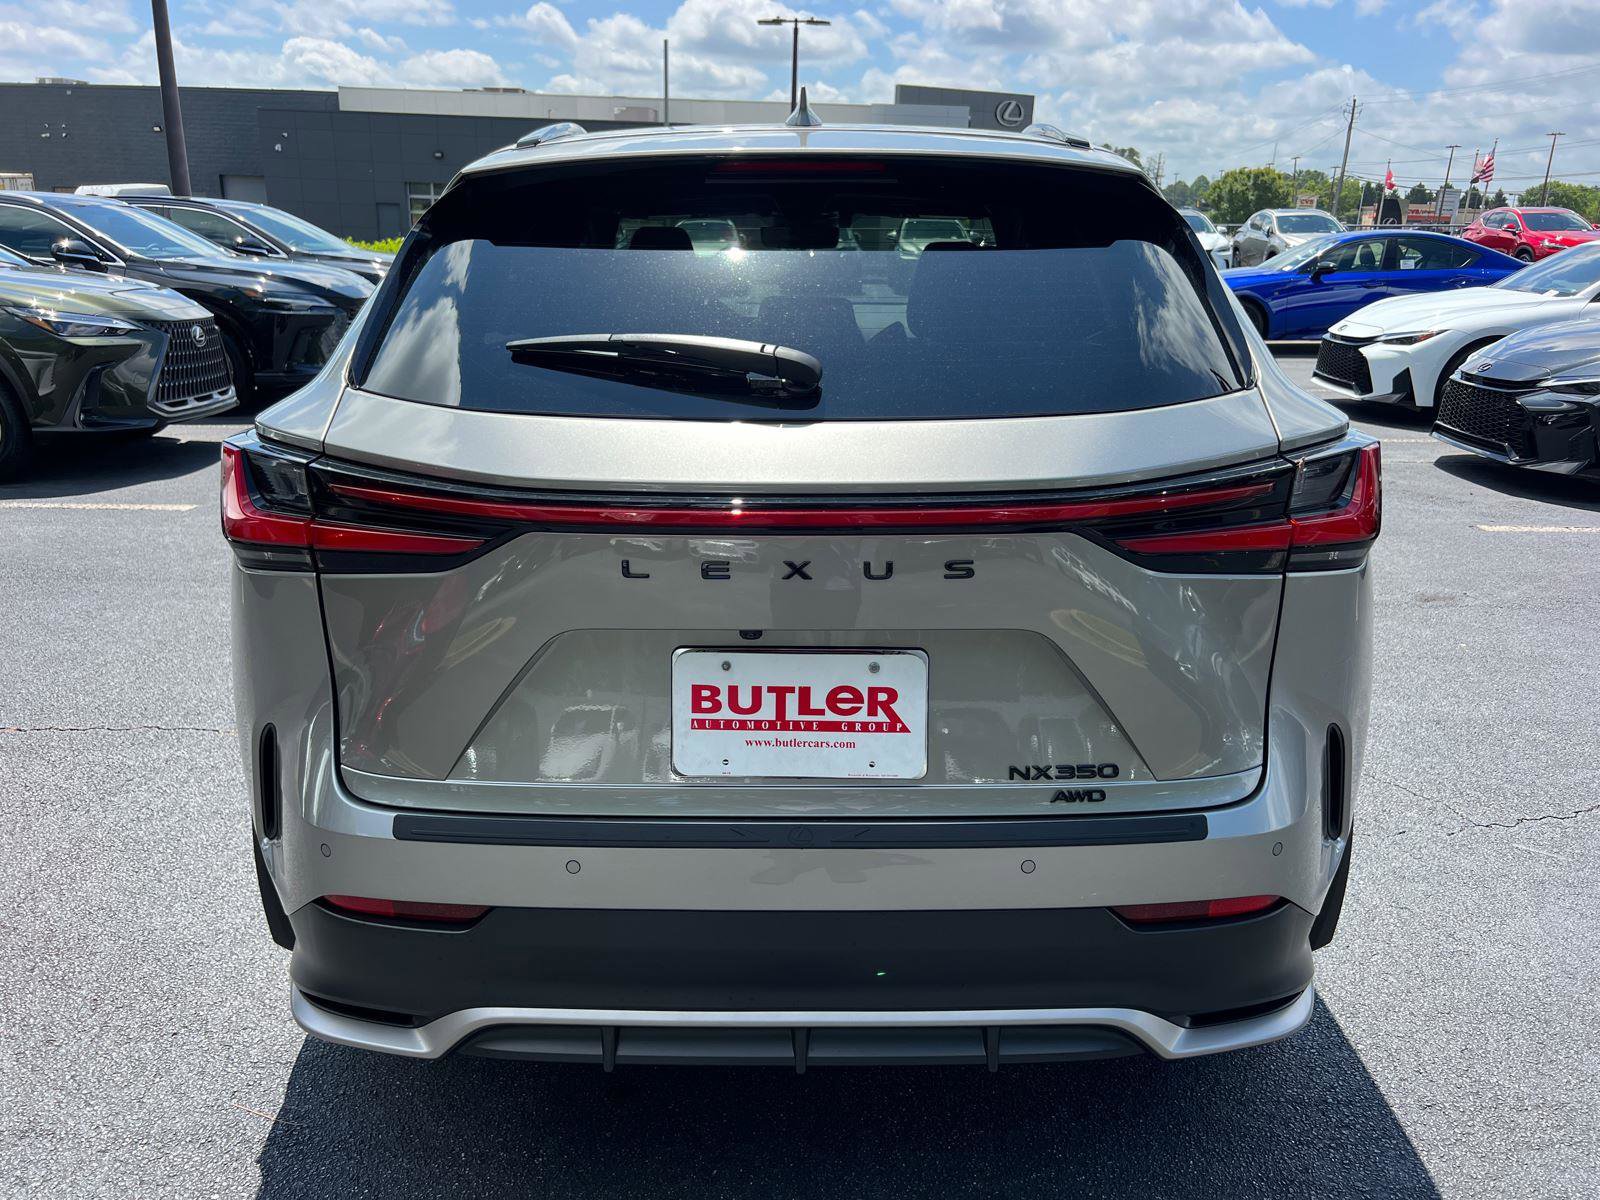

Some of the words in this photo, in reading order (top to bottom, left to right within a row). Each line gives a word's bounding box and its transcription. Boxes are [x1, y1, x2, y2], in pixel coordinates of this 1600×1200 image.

[621, 559, 975, 581] LEXUS
[691, 719, 819, 731] AUTOMOTIVE
[841, 721, 904, 732] GROUP
[744, 737, 857, 749] www.butlercars.com
[1008, 762, 1120, 780] NX350
[1050, 789, 1107, 803] AWD
